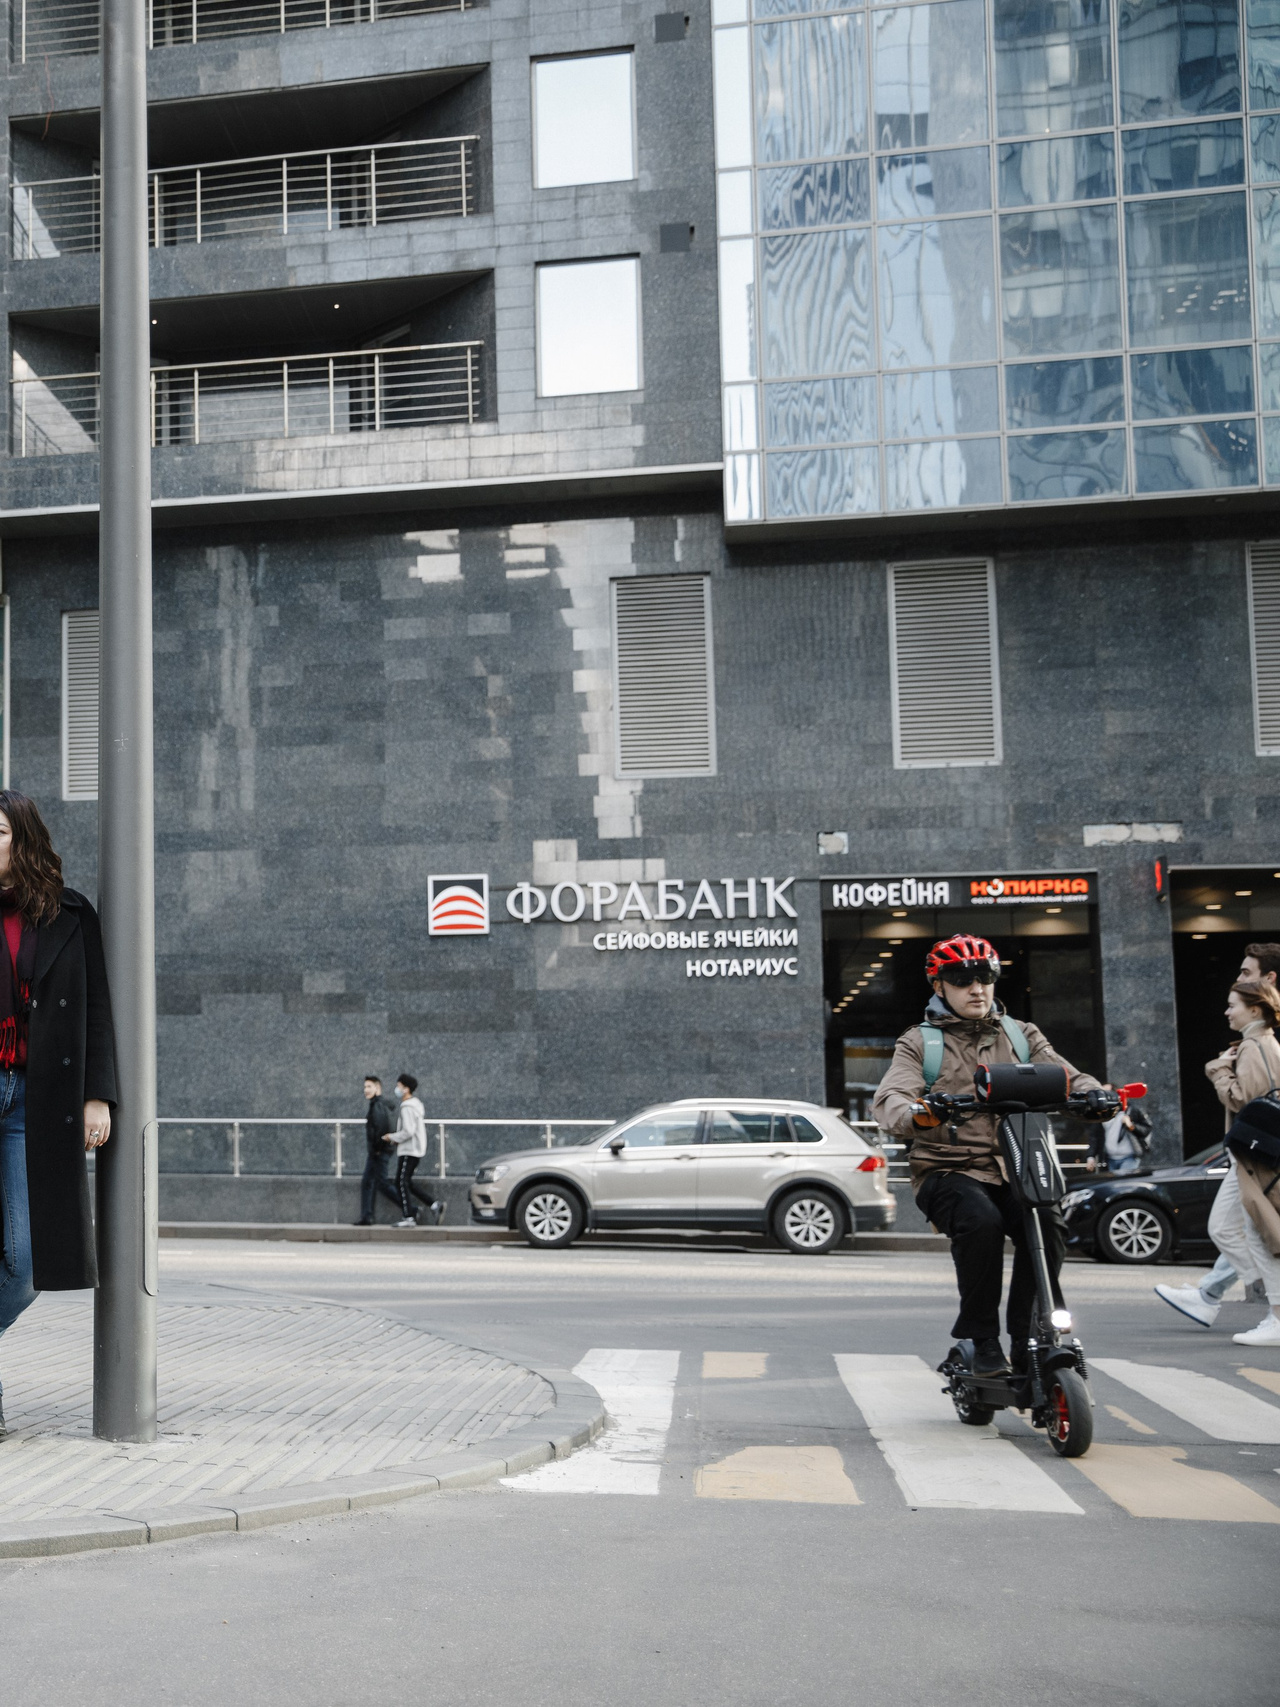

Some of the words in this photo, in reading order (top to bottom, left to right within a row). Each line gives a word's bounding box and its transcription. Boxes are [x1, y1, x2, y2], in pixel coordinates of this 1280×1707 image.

[505, 876, 799, 923] ФОРАБАНК
[832, 878, 950, 908] КОФЕЙНЯ
[970, 878, 1089, 897] КОПИРКА
[593, 930, 710, 951] СЕЙФОВЫЕ
[713, 927, 799, 948] ЯЧЕЙКИ
[686, 957, 799, 978] НОТАРИУС
